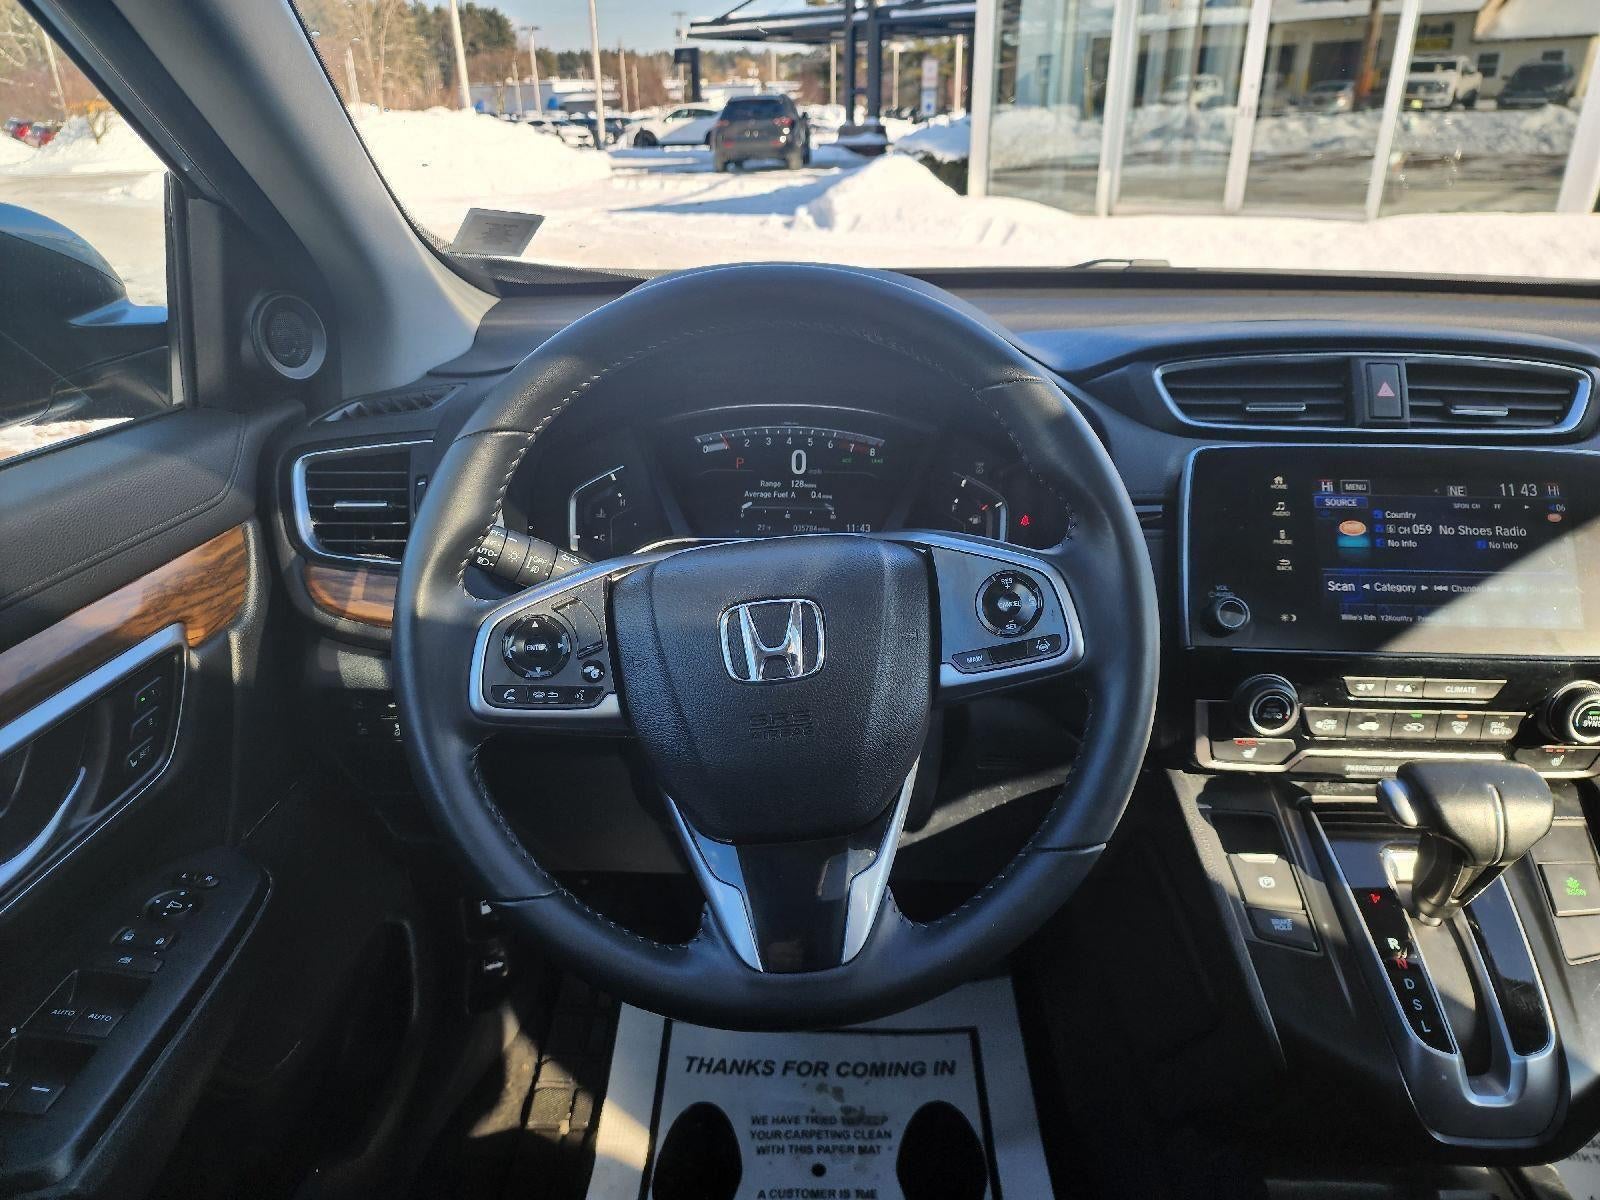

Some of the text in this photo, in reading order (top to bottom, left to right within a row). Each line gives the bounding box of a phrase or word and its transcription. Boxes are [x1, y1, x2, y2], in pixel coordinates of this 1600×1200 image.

[744, 438, 750, 448] 2
[766, 437, 772, 446] 3
[786, 436, 792, 446] 4
[808, 438, 814, 447] 5
[828, 440, 834, 449] 6
[850, 444, 855, 453] 7
[869, 448, 876, 458] 8
[736, 457, 744, 470] P
[791, 450, 807, 475] 0
[760, 480, 782, 489] Range
[1322, 482, 1334, 492] Hi
[744, 491, 772, 500] Average
[1449, 486, 1464, 496] NE
[1548, 486, 1560, 496] Hi
[1325, 498, 1358, 507] SOURCE
[1386, 510, 1416, 520] Country
[846, 524, 871, 532] 11:43
[1398, 524, 1527, 537] CH 059 No Shoes Radio
[1388, 540, 1418, 548] No Info
[1488, 542, 1518, 550] No Info
[1328, 580, 1356, 592] Scan
[1374, 582, 1416, 593] Category
[1445, 686, 1478, 694] CLIMATE
[1387, 938, 1400, 950] R
[1404, 978, 1415, 990] D
[1412, 999, 1422, 1011] S
[88, 1013, 112, 1022] AUTO
[1421, 1020, 1431, 1032] L
[685, 1056, 956, 1078] THANKS FOR COMING IN
[752, 1115, 768, 1125] WE
[771, 1115, 800, 1125] HAVE
[805, 1115, 838, 1125] TRIED
[750, 1130, 892, 1140] YOUR CARPETING CLEAN
[756, 1145, 882, 1155] WITH THIS PAPER MAT
[757, 1188, 766, 1199] A
[769, 1188, 838, 1200] CUSTOMER
[839, 1188, 850, 1199] IS
